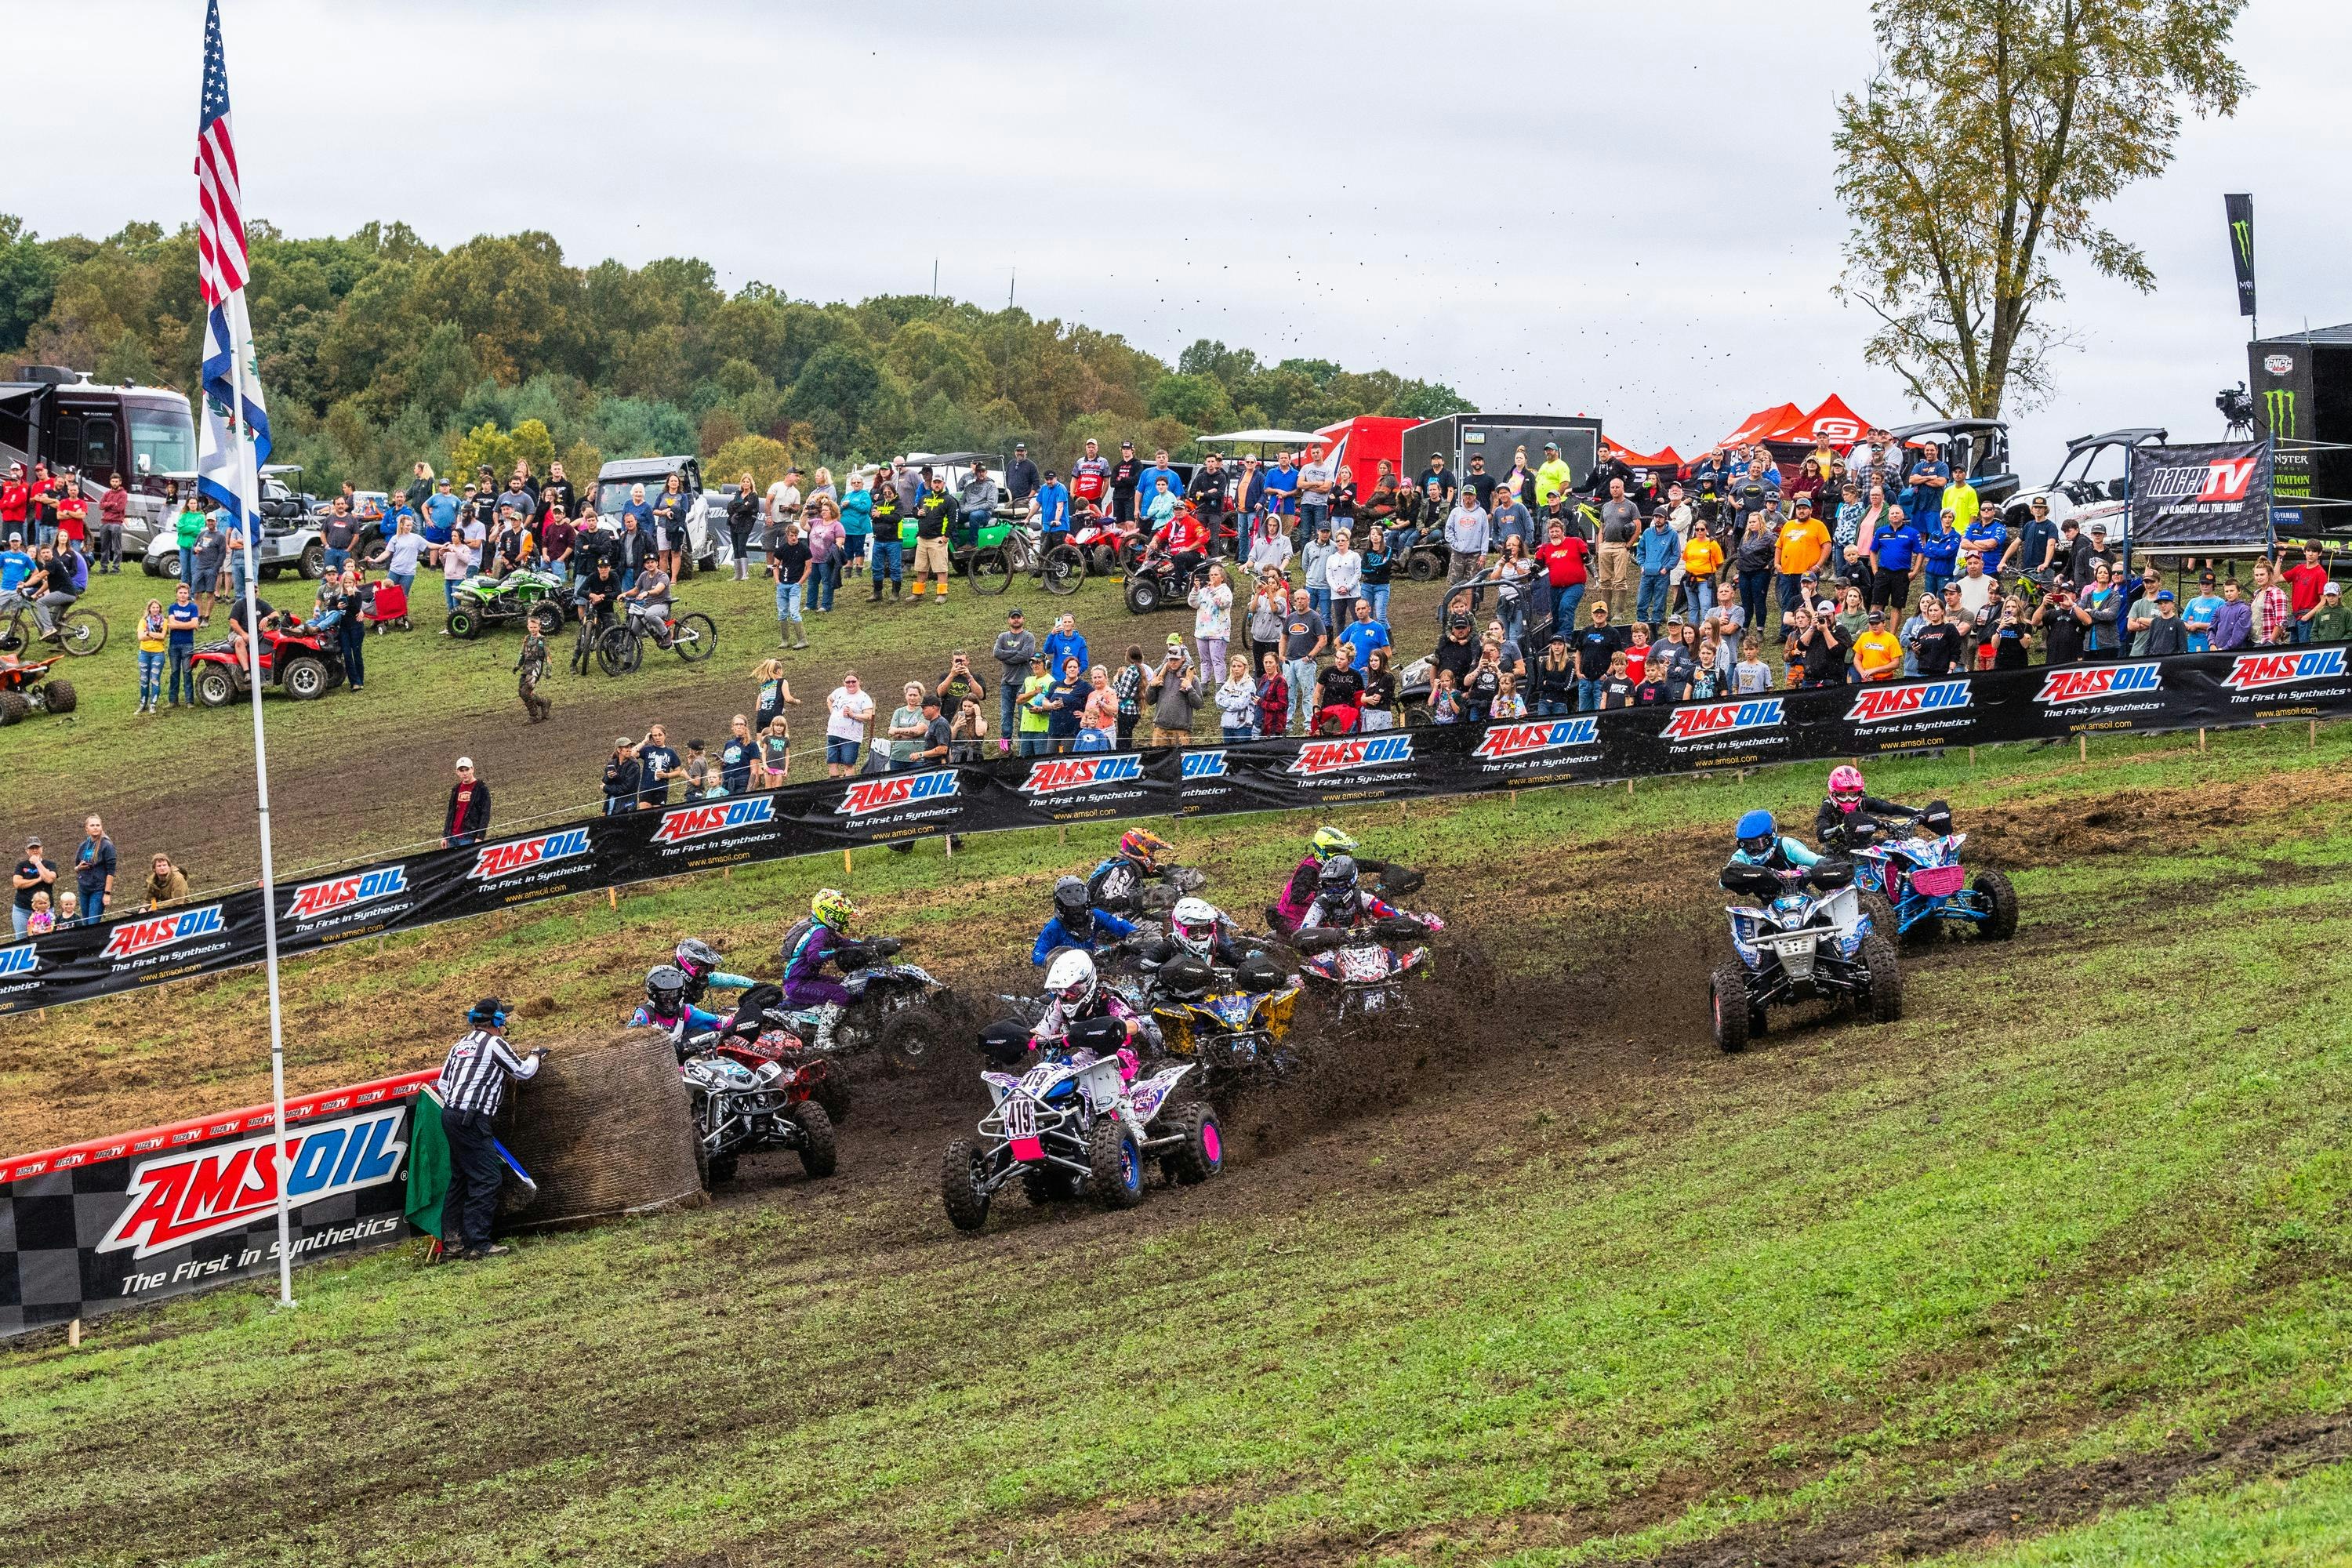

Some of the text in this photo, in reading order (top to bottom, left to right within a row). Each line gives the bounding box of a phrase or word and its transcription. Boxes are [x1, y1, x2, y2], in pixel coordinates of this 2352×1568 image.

[2266, 358, 2292, 368] GNCC
[2274, 453, 2309, 464] NSTER
[2273, 474, 2310, 485] TIVATION
[2273, 488, 2311, 498] ANSPORT
[2169, 504, 2198, 514] RACING!
[2198, 504, 2209, 513] ALL
[2212, 503, 2223, 513] THE
[2224, 503, 2243, 513] TIME!
[2227, 650, 2345, 688] AMSOIL
[1329, 673, 1354, 683] SENIORS
[2039, 665, 2160, 703] AMSOIL
[1610, 683, 1628, 694] NIKE
[2289, 688, 2346, 699] Synthetics
[1850, 681, 1970, 722] AMSOIL
[2103, 702, 2160, 713] Synthetics
[1666, 699, 1784, 739] AMSOIL
[2256, 707, 2318, 717] www.amsoil.com
[1915, 719, 1971, 731] Synthetics
[2070, 720, 2132, 731] www.amsoil.com
[1479, 718, 1597, 757] AMSOIL
[1728, 736, 1784, 749] Synthetics
[1880, 737, 1944, 749] www.amsoil.com
[1294, 735, 1412, 775] AMSOIL
[1542, 755, 1599, 768] Synthetics
[1695, 755, 1758, 767] www.amsoil.com
[1181, 753, 1225, 775] OIL
[1029, 755, 1141, 793] AMSOIL
[1356, 772, 1412, 784] Synthetics
[1507, 773, 1571, 785] www.amsoil.com
[841, 771, 959, 814] AMSOIL
[1088, 790, 1143, 802] Synthetics
[1323, 790, 1385, 801] www.amsoil.com
[657, 797, 773, 842] AMSOIL
[905, 808, 959, 820] Synthetics
[1054, 808, 1116, 819] www.amsoil.com
[872, 825, 935, 840] www.amsoil.com
[682, 844, 706, 853] First
[721, 833, 776, 847] Synthetics
[474, 829, 590, 877] AMSOIL
[688, 852, 750, 867] www.amsoil.com
[499, 878, 522, 888] First
[537, 863, 592, 880] Synthetics
[290, 867, 405, 917] AMSOIL
[505, 884, 567, 902] www.amsoil.com
[296, 924, 314, 932] The
[316, 918, 339, 928] First
[354, 902, 408, 920] Synthetics
[106, 906, 224, 956] AMSOIL
[321, 923, 384, 942] www.amsoil.com
[0, 946, 38, 973] OIL
[111, 964, 130, 972] The
[132, 957, 157, 968] First
[172, 942, 226, 960] Synthetics
[139, 963, 201, 982] www.amsoil.com
[1022, 1071, 1048, 1087] 419
[1008, 1101, 1031, 1134] 419
[114, 1116, 400, 1248] AMSOIL
[122, 1216, 399, 1294] The First in Synthetics
